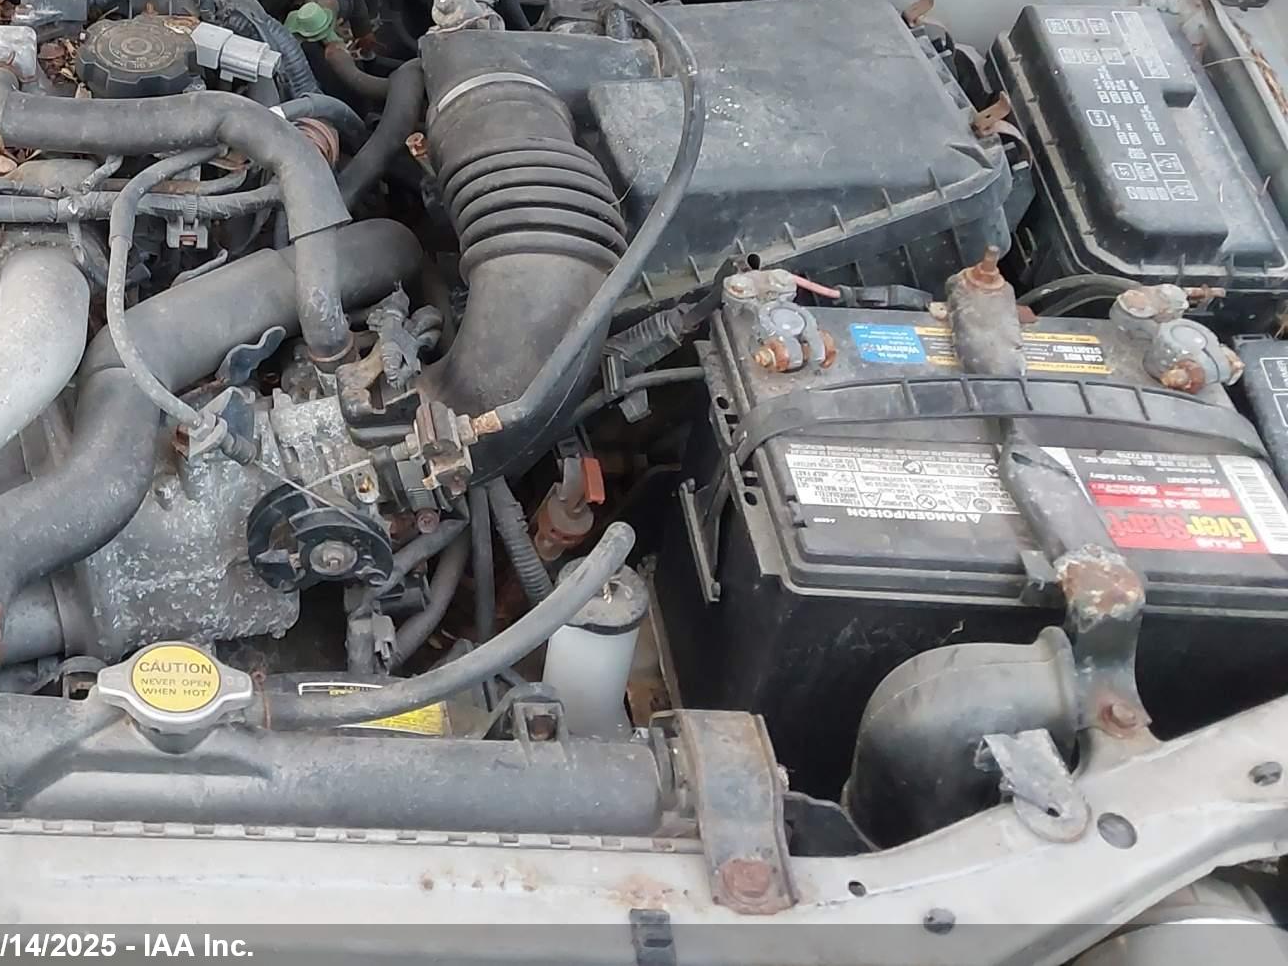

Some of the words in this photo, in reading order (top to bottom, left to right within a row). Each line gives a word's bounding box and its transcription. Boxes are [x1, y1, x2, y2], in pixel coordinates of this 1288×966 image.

[876, 344, 920, 354] Walmart
[138, 660, 213, 675] CAUTION
[140, 677, 177, 687] NEVER
[181, 678, 212, 688] OPEN
[141, 686, 179, 697] WHEN
[183, 687, 207, 698] HOT
